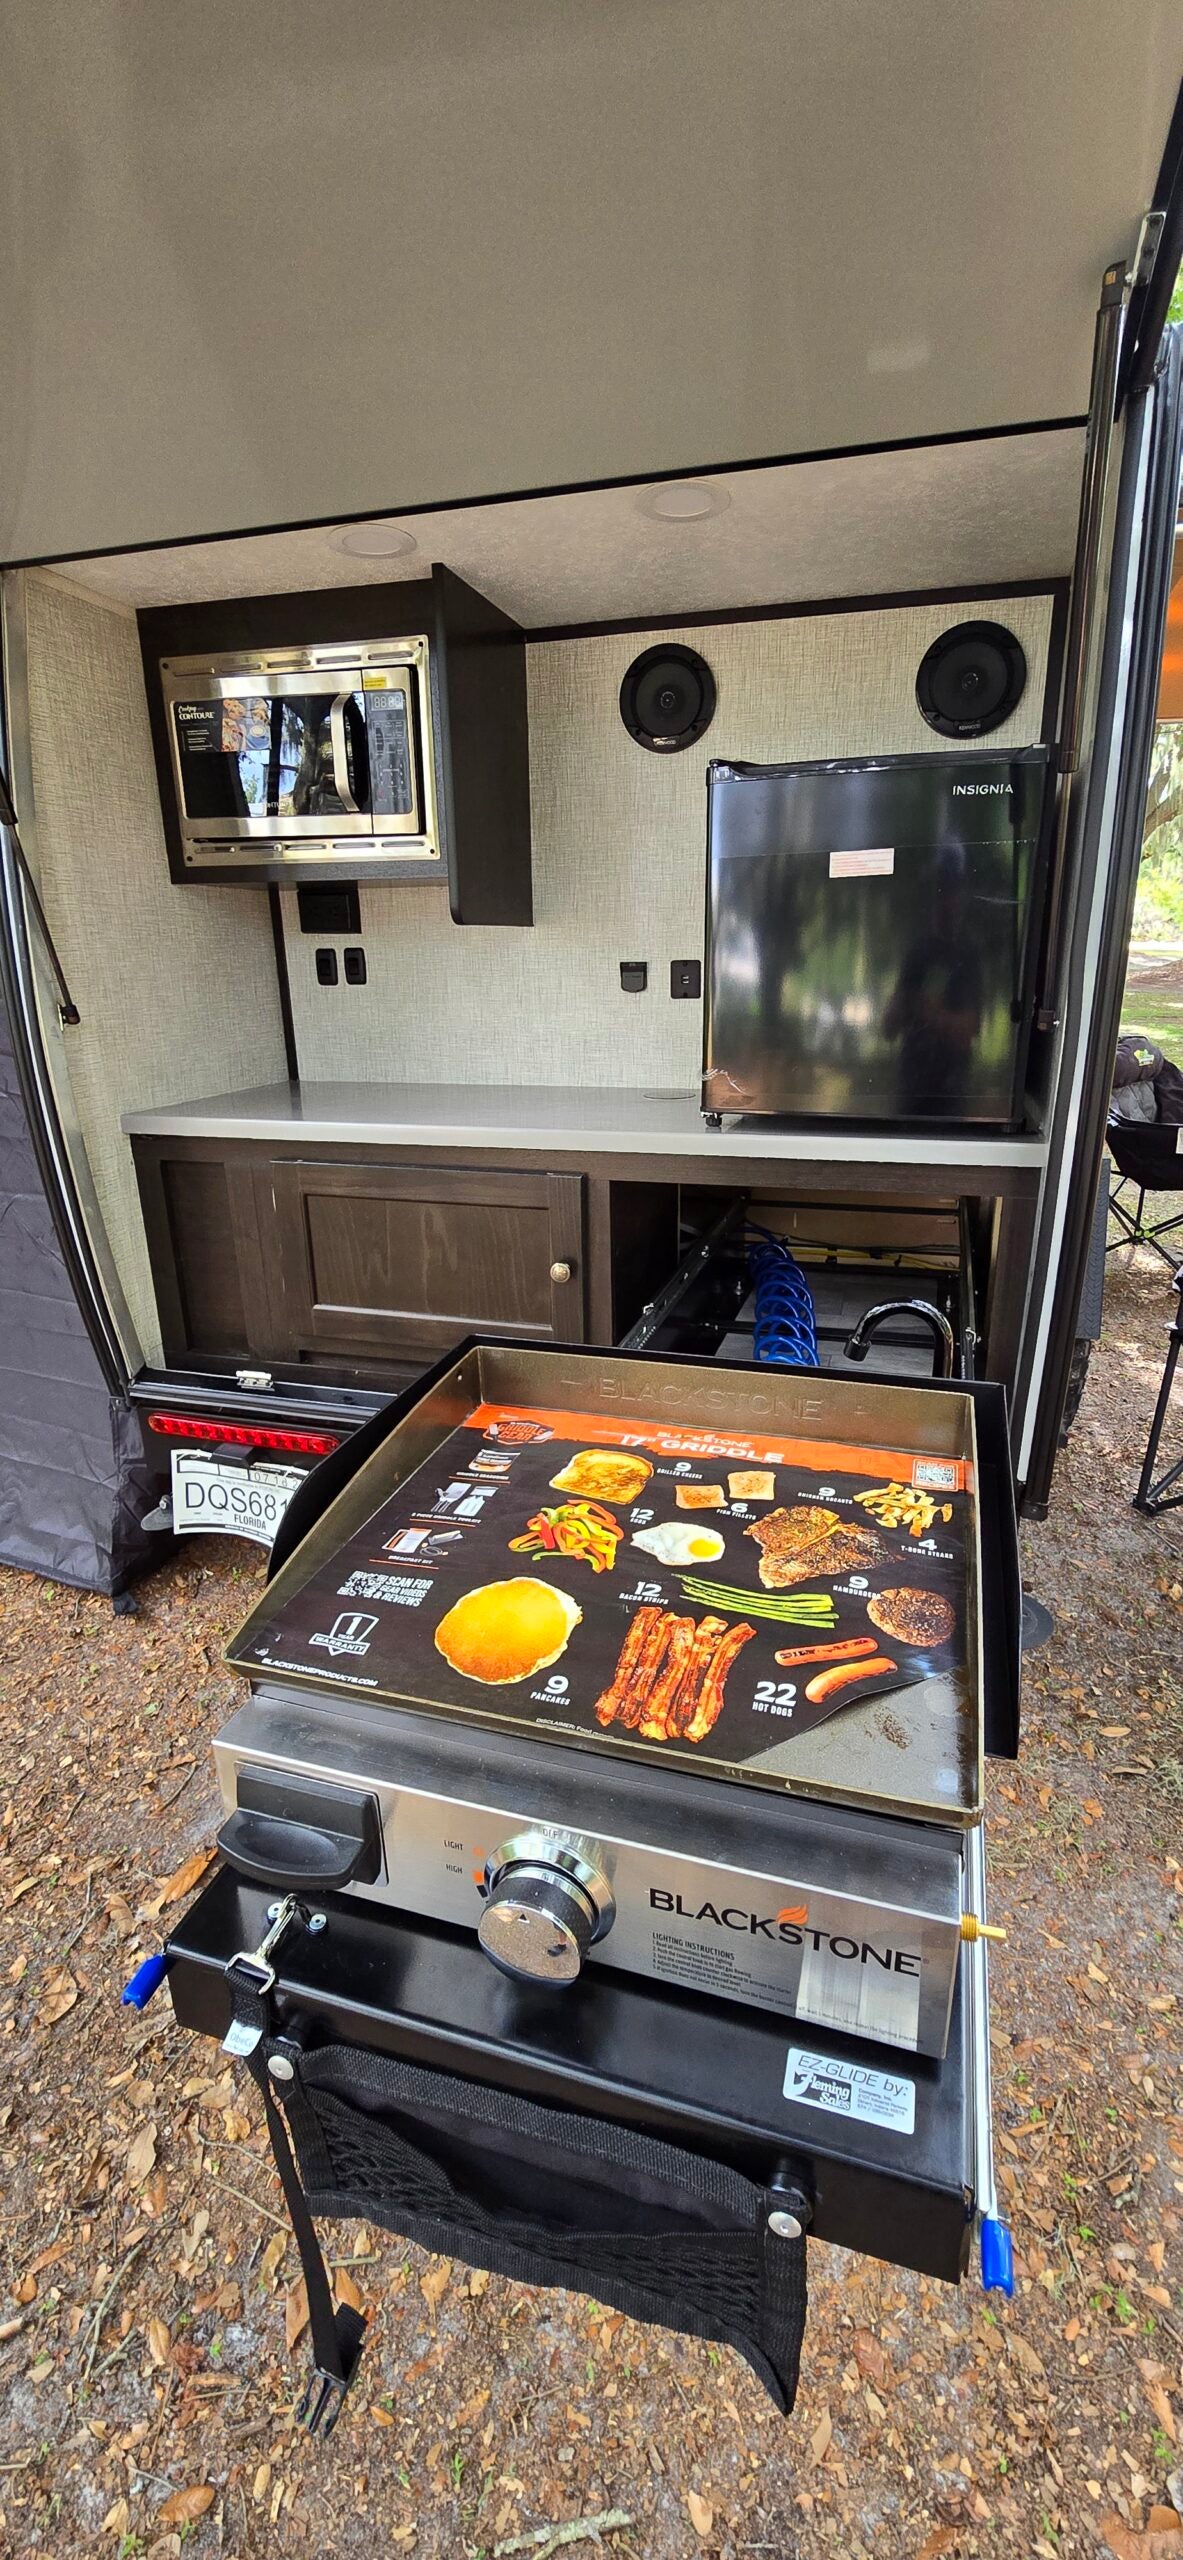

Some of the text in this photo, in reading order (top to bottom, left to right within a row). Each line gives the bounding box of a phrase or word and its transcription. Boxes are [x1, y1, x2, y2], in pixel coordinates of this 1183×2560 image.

[952, 783, 1014, 796] INSIGNIA
[599, 1377, 824, 1422] BLACKSTONE
[660, 1438, 785, 1464] GRIDDLE
[674, 1461, 692, 1473] 9
[818, 1486, 836, 1497] 9
[630, 1507, 655, 1521] 12
[730, 1502, 749, 1513] 6
[234, 1513, 267, 1531] FLORIDA
[918, 1538, 938, 1551] 4
[379, 1584, 428, 1598] GEAR VIDEOS
[386, 1575, 434, 1590] SCAN FOR
[634, 1581, 662, 1598] 12
[848, 1575, 869, 1590] 9
[381, 1592, 423, 1608] REVIEWS
[618, 1593, 643, 1602] BACON
[345, 1616, 363, 1636] 1
[315, 1635, 366, 1653] WARRANTY
[261, 1657, 379, 1687] BLACKSTONEPRODUCTS.COM
[544, 1675, 569, 1695] 9
[754, 1680, 797, 1707] 22
[530, 1691, 571, 1706] PANCAKES
[752, 1701, 793, 1718] HOT DOGS
[443, 1839, 463, 1851] LIGHT
[446, 1863, 463, 1874] HIGH
[650, 1887, 921, 1977] BLACKSTONE
[652, 1932, 734, 1960] LIGHTING INSTRUCTIONS
[798, 2055, 909, 2097] EZ-GLIDE by:
[794, 2070, 850, 2101] Fleming
[819, 2091, 850, 2111] Sales
